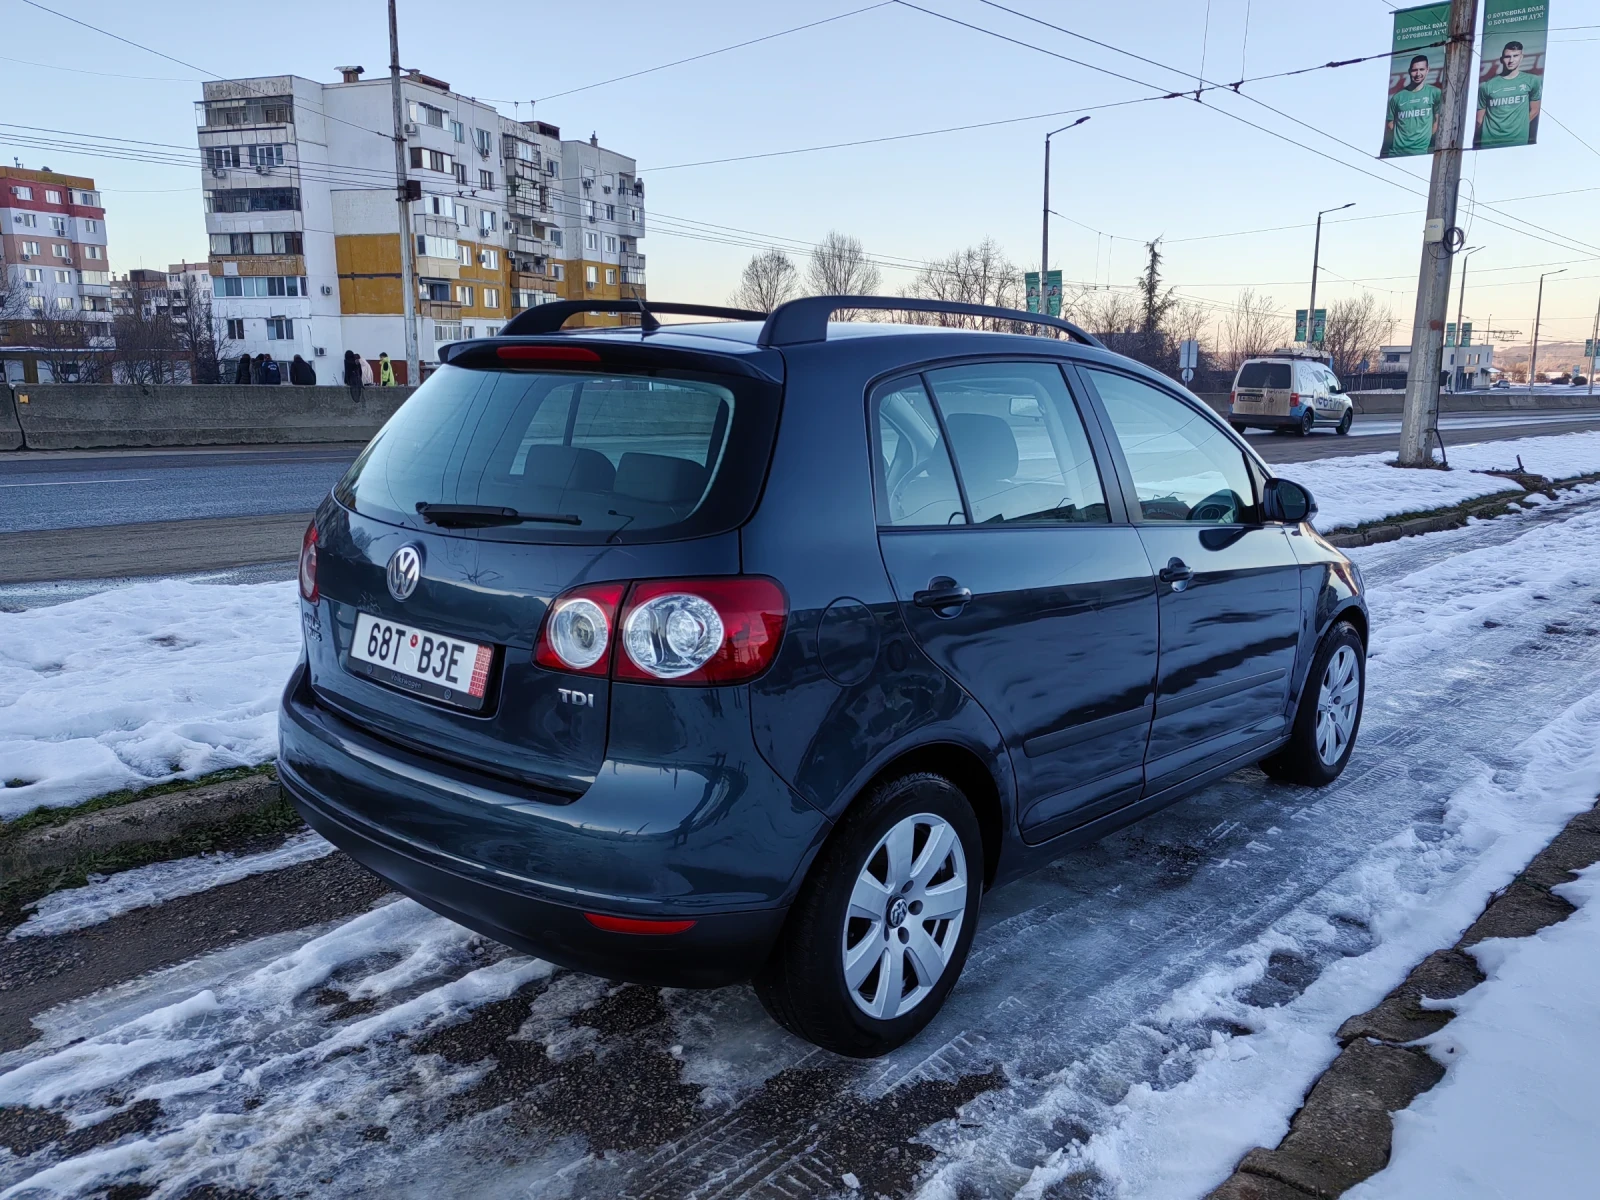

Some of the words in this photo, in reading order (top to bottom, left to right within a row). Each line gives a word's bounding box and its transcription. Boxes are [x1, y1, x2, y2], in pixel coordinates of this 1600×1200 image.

[1489, 95, 1527, 106] WINBET
[1398, 108, 1432, 119] WINBET
[368, 622, 406, 665] 68T
[417, 636, 465, 684] B3E
[558, 688, 594, 708] TDI
